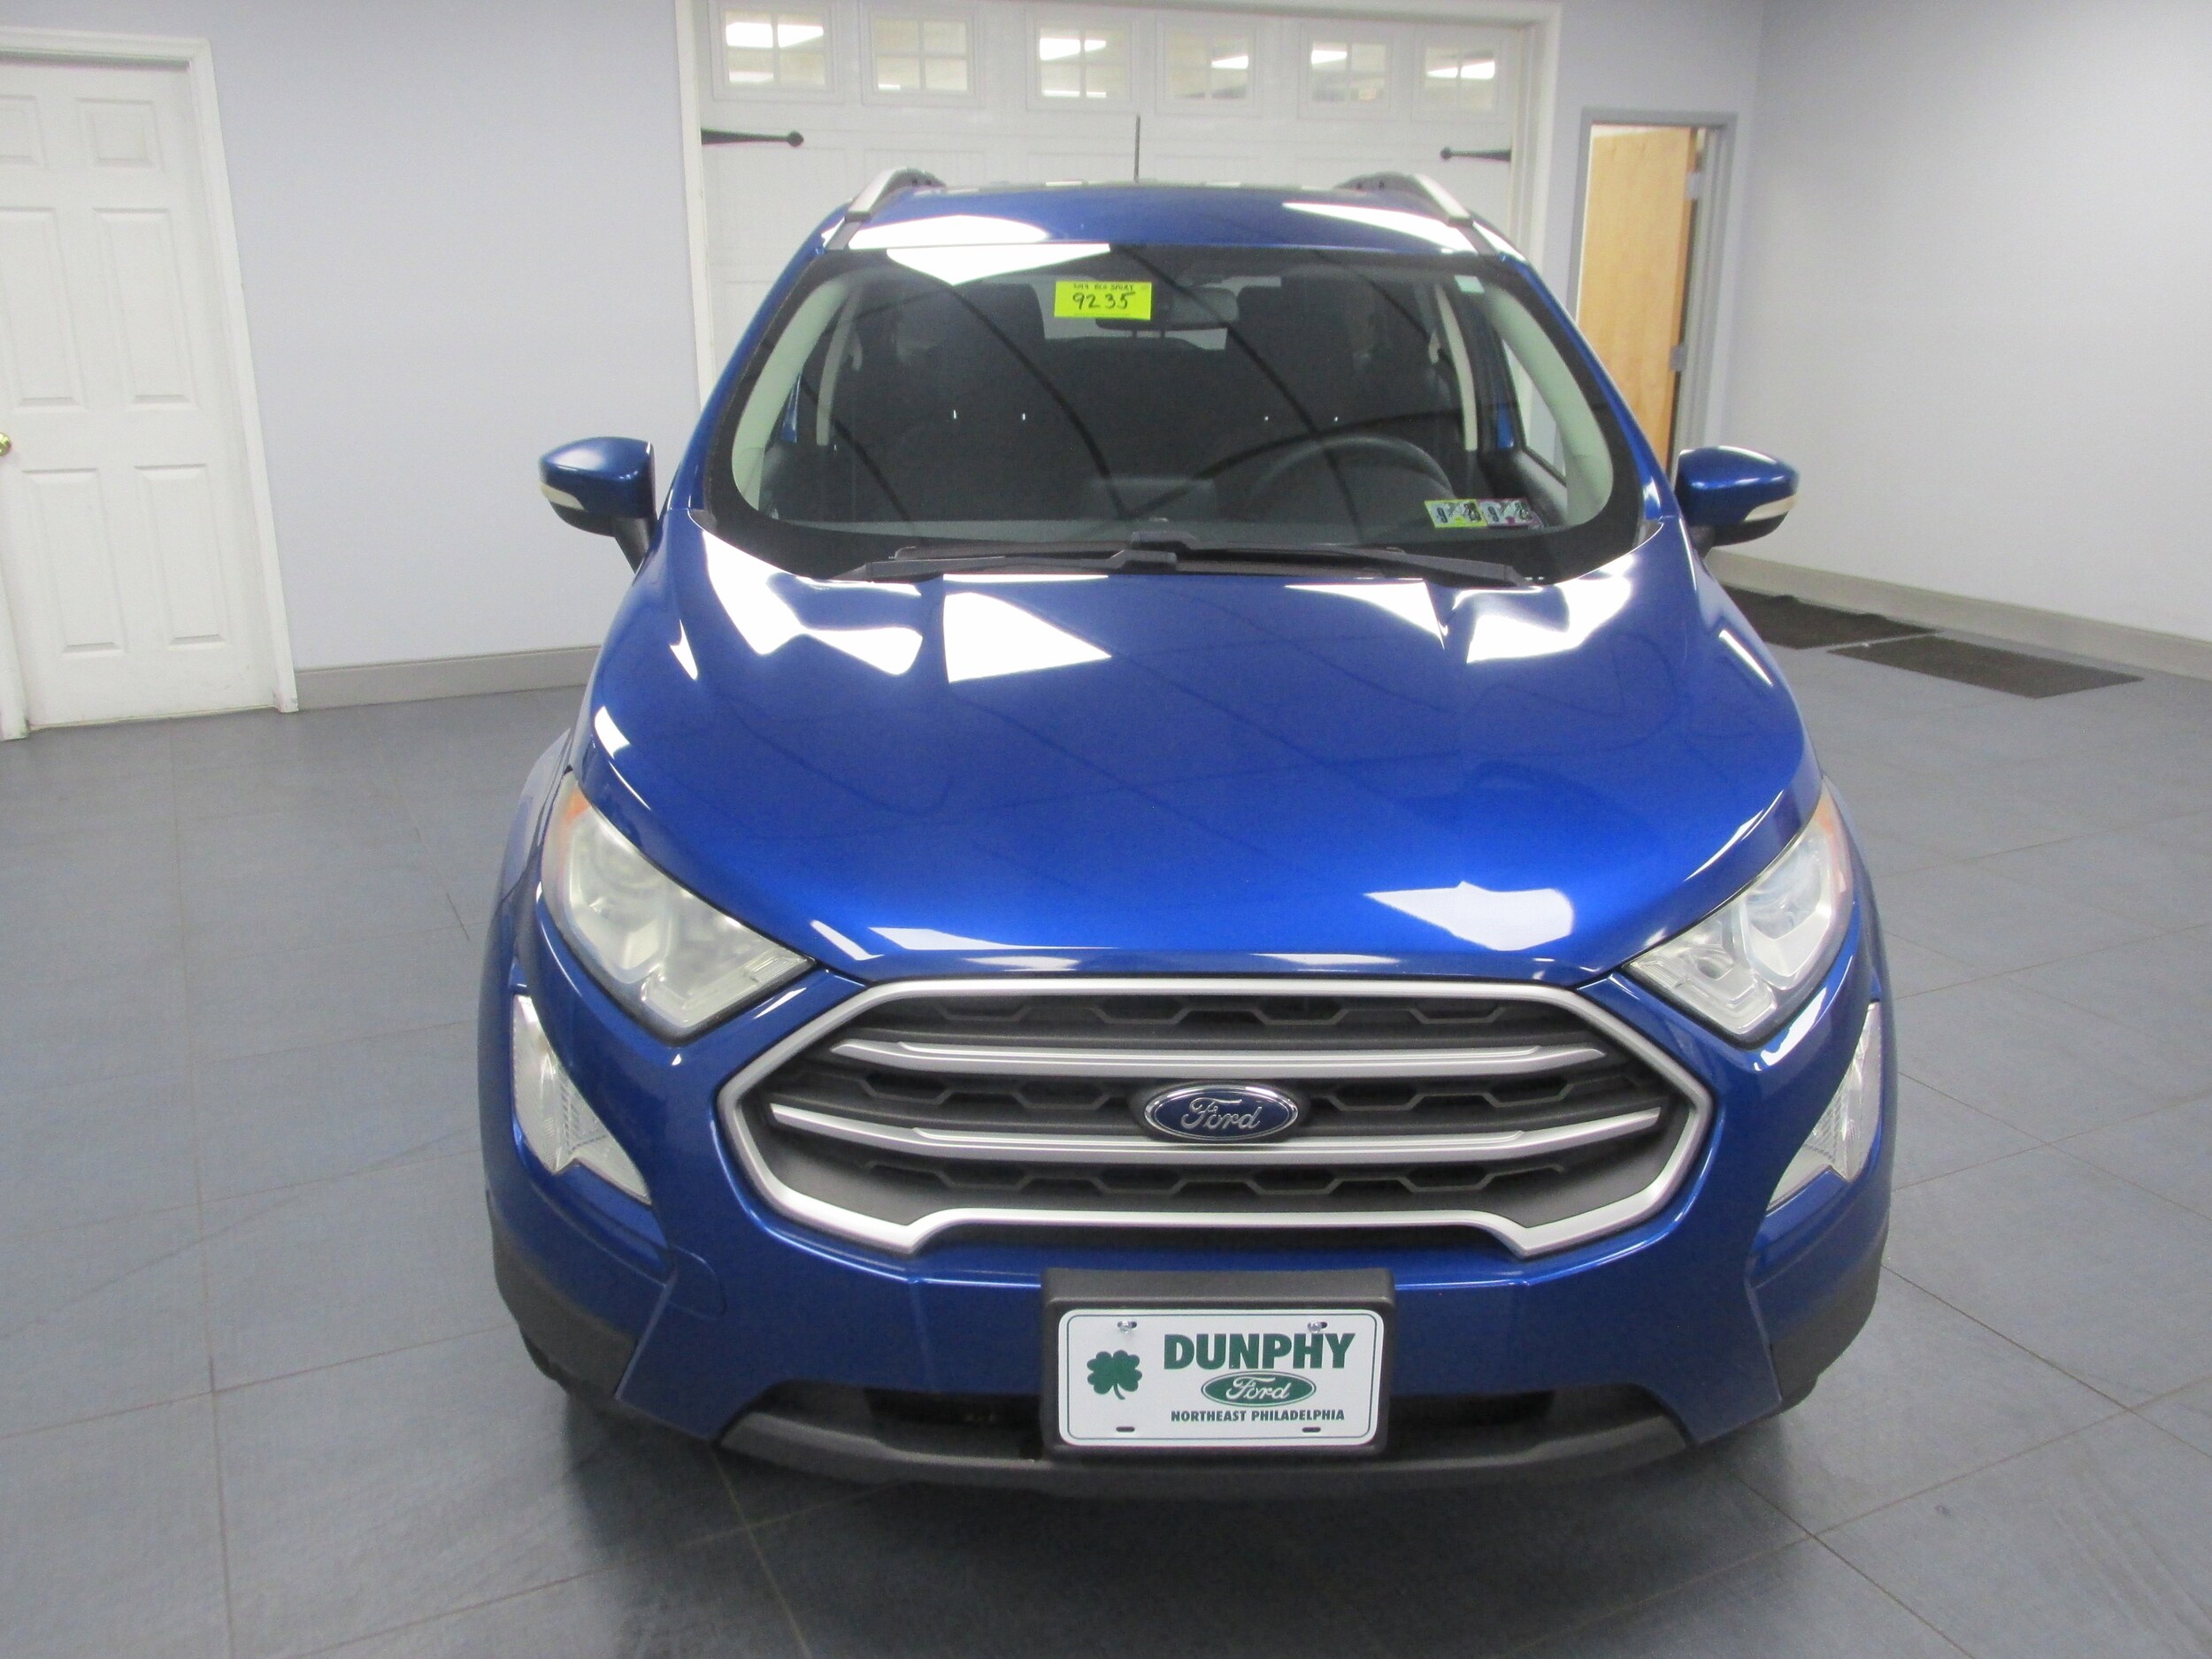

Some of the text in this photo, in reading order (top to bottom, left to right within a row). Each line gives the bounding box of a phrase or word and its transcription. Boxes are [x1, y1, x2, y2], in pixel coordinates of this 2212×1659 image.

[1072, 292, 1136, 310] 9235
[1180, 1097, 1263, 1130] Ford
[1164, 1333, 1356, 1370] DUNPHY
[1225, 1376, 1292, 1400] Ford
[1171, 1409, 1346, 1422] NORTHEAST PHILADELPHIA
